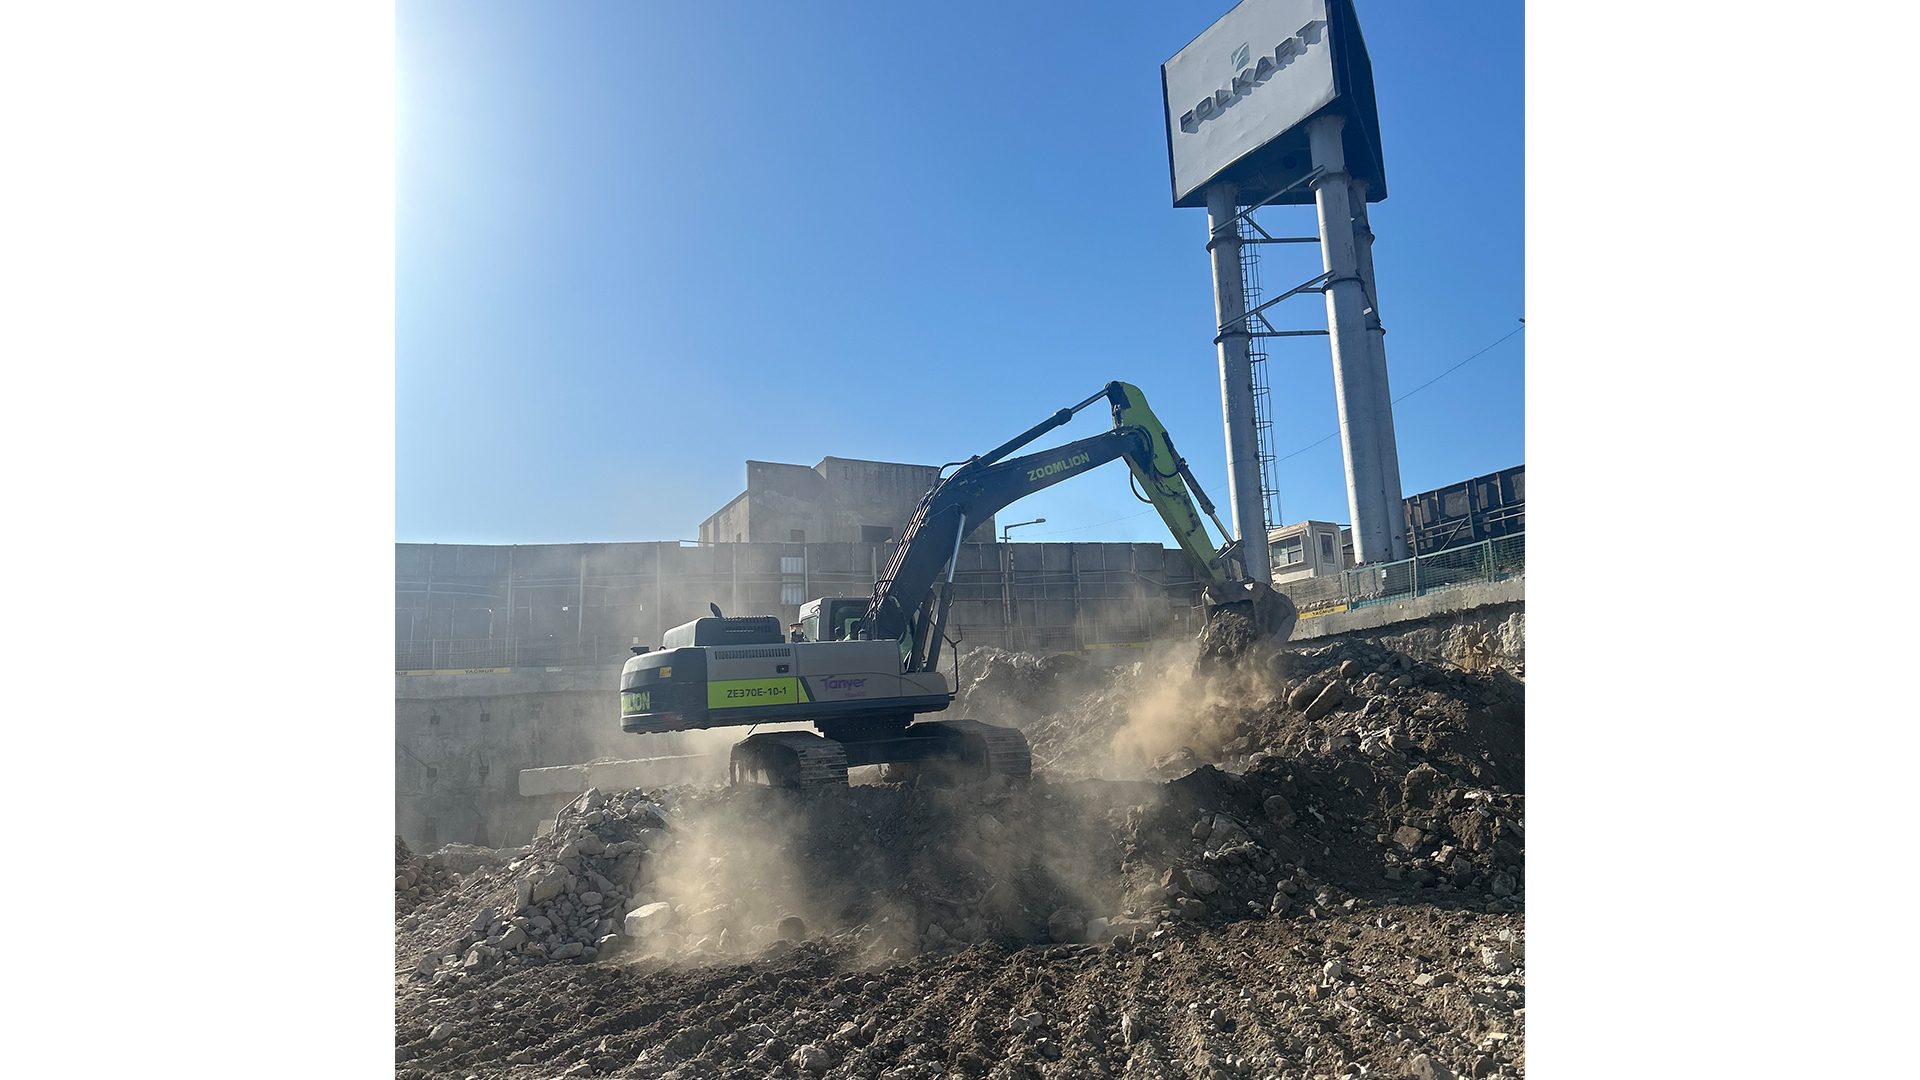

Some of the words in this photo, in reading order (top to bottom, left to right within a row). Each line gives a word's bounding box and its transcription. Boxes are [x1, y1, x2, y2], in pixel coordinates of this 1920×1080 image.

[1179, 20, 1327, 133] FOLKART
[1027, 452, 1090, 481] ZOOMLION
[623, 691, 650, 713] LION
[727, 686, 787, 698] ZE370E-10-1
